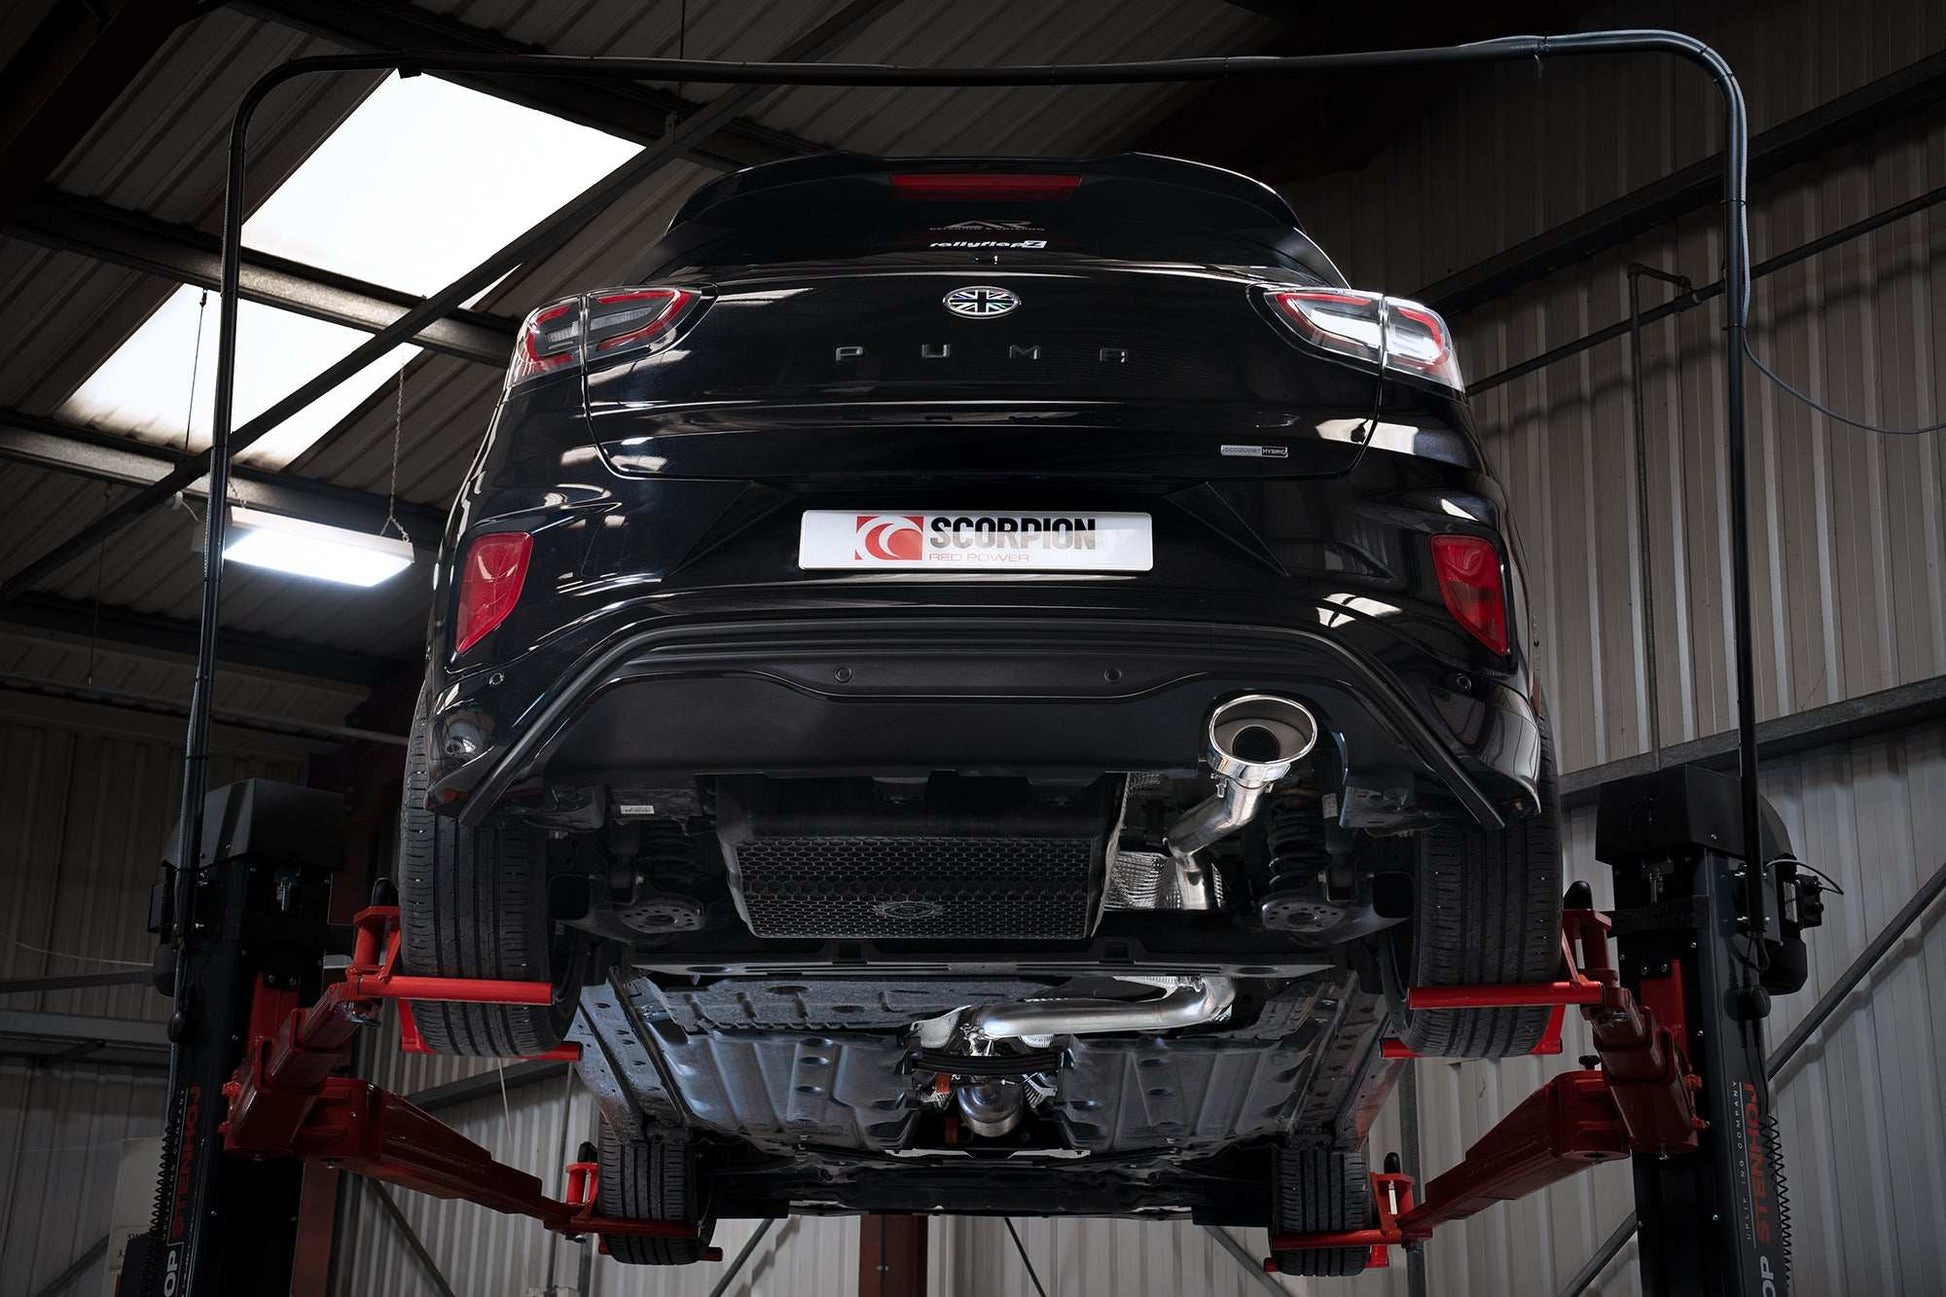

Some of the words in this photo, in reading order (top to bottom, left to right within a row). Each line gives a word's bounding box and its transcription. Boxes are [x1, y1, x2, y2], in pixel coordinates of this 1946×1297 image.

[835, 344, 1129, 364] PUMA
[931, 516, 1096, 550] SCORPION
[929, 553, 961, 562] RED
[967, 553, 1030, 562] POWER
